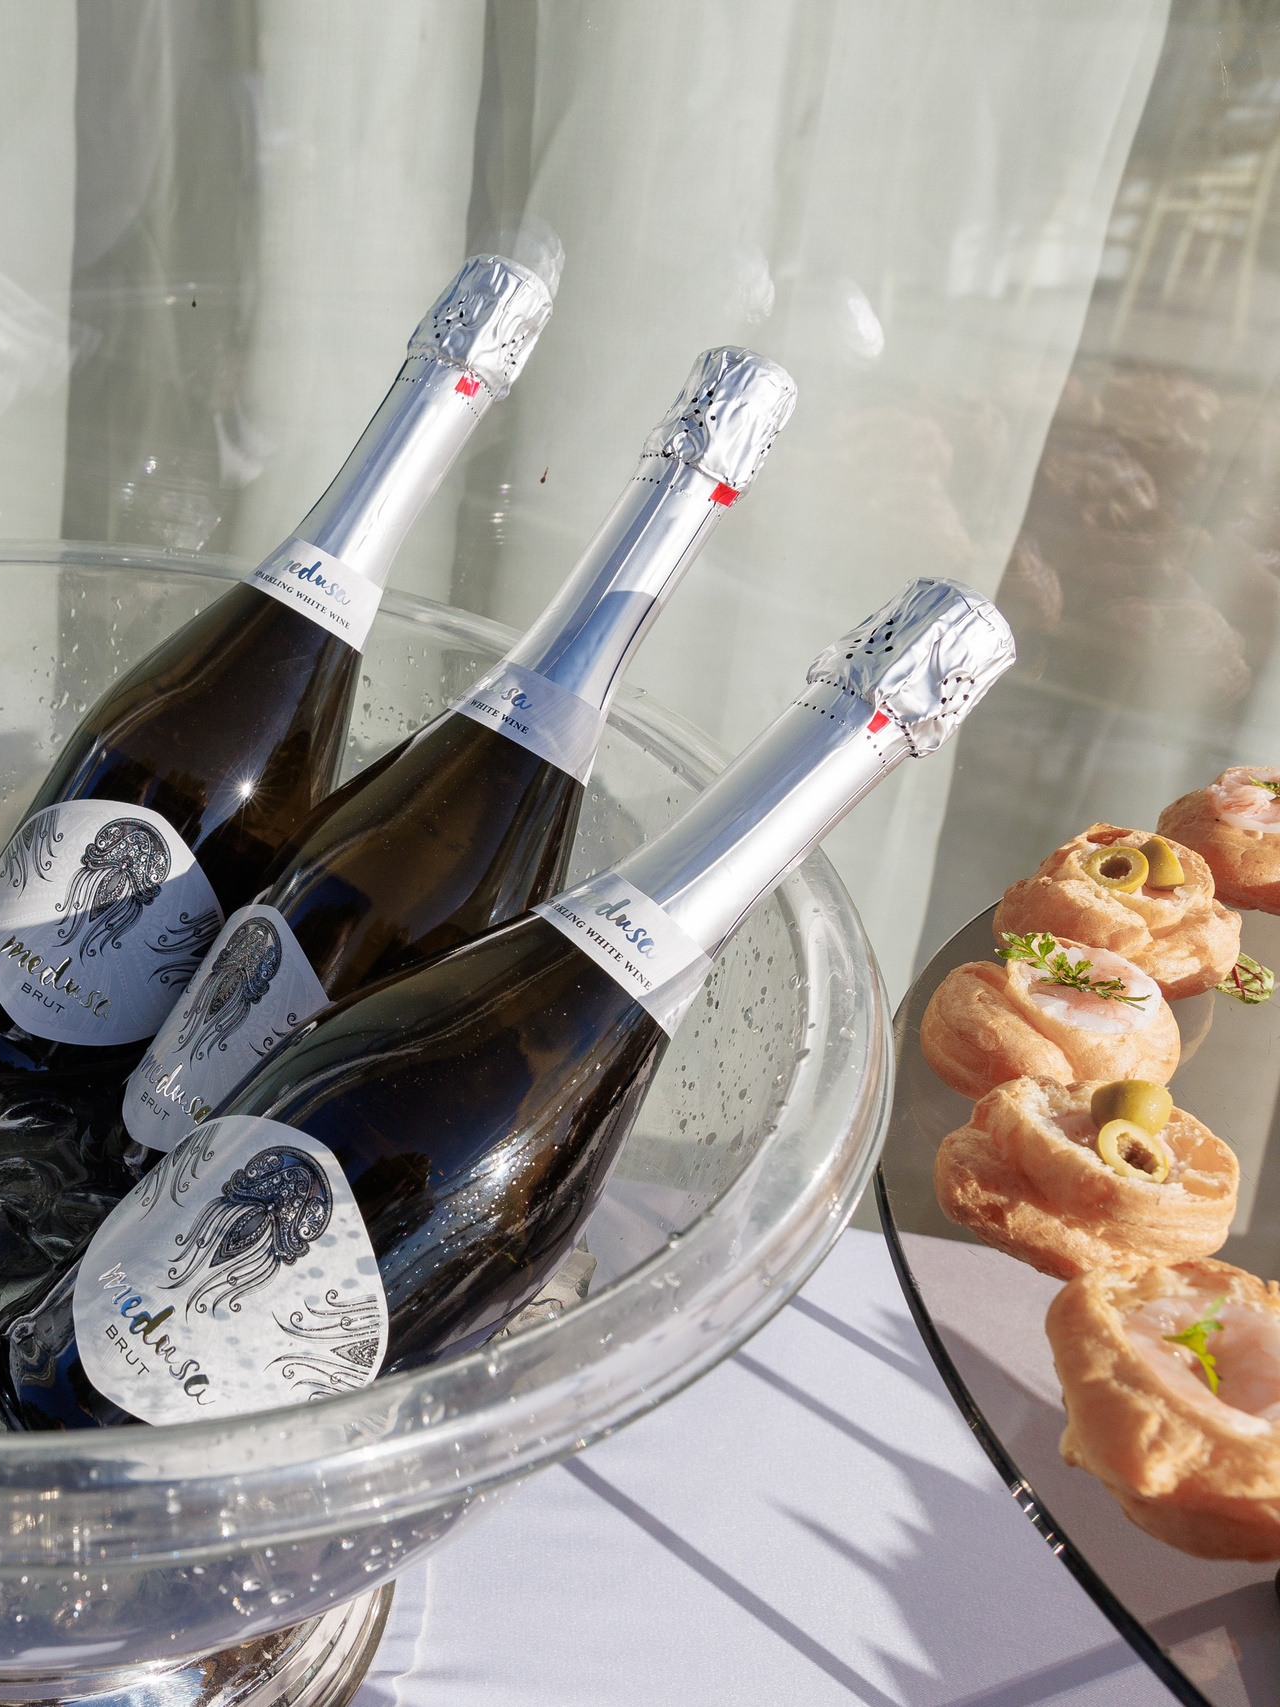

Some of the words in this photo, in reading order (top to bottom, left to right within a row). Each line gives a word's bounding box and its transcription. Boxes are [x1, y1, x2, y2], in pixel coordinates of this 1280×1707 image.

[272, 554, 352, 606] medusa
[295, 590, 328, 615] WHITE
[328, 610, 351, 630] WINE
[469, 698, 501, 718] WHITE
[501, 713, 530, 735] WINE
[0, 934, 113, 1022] medusa
[585, 927, 624, 963] WHITE
[623, 960, 653, 991] WINE
[20, 981, 66, 1014] BRUT
[140, 1091, 170, 1121] BRUT
[98, 1262, 216, 1406] medusa
[105, 1323, 151, 1376] BRUT
